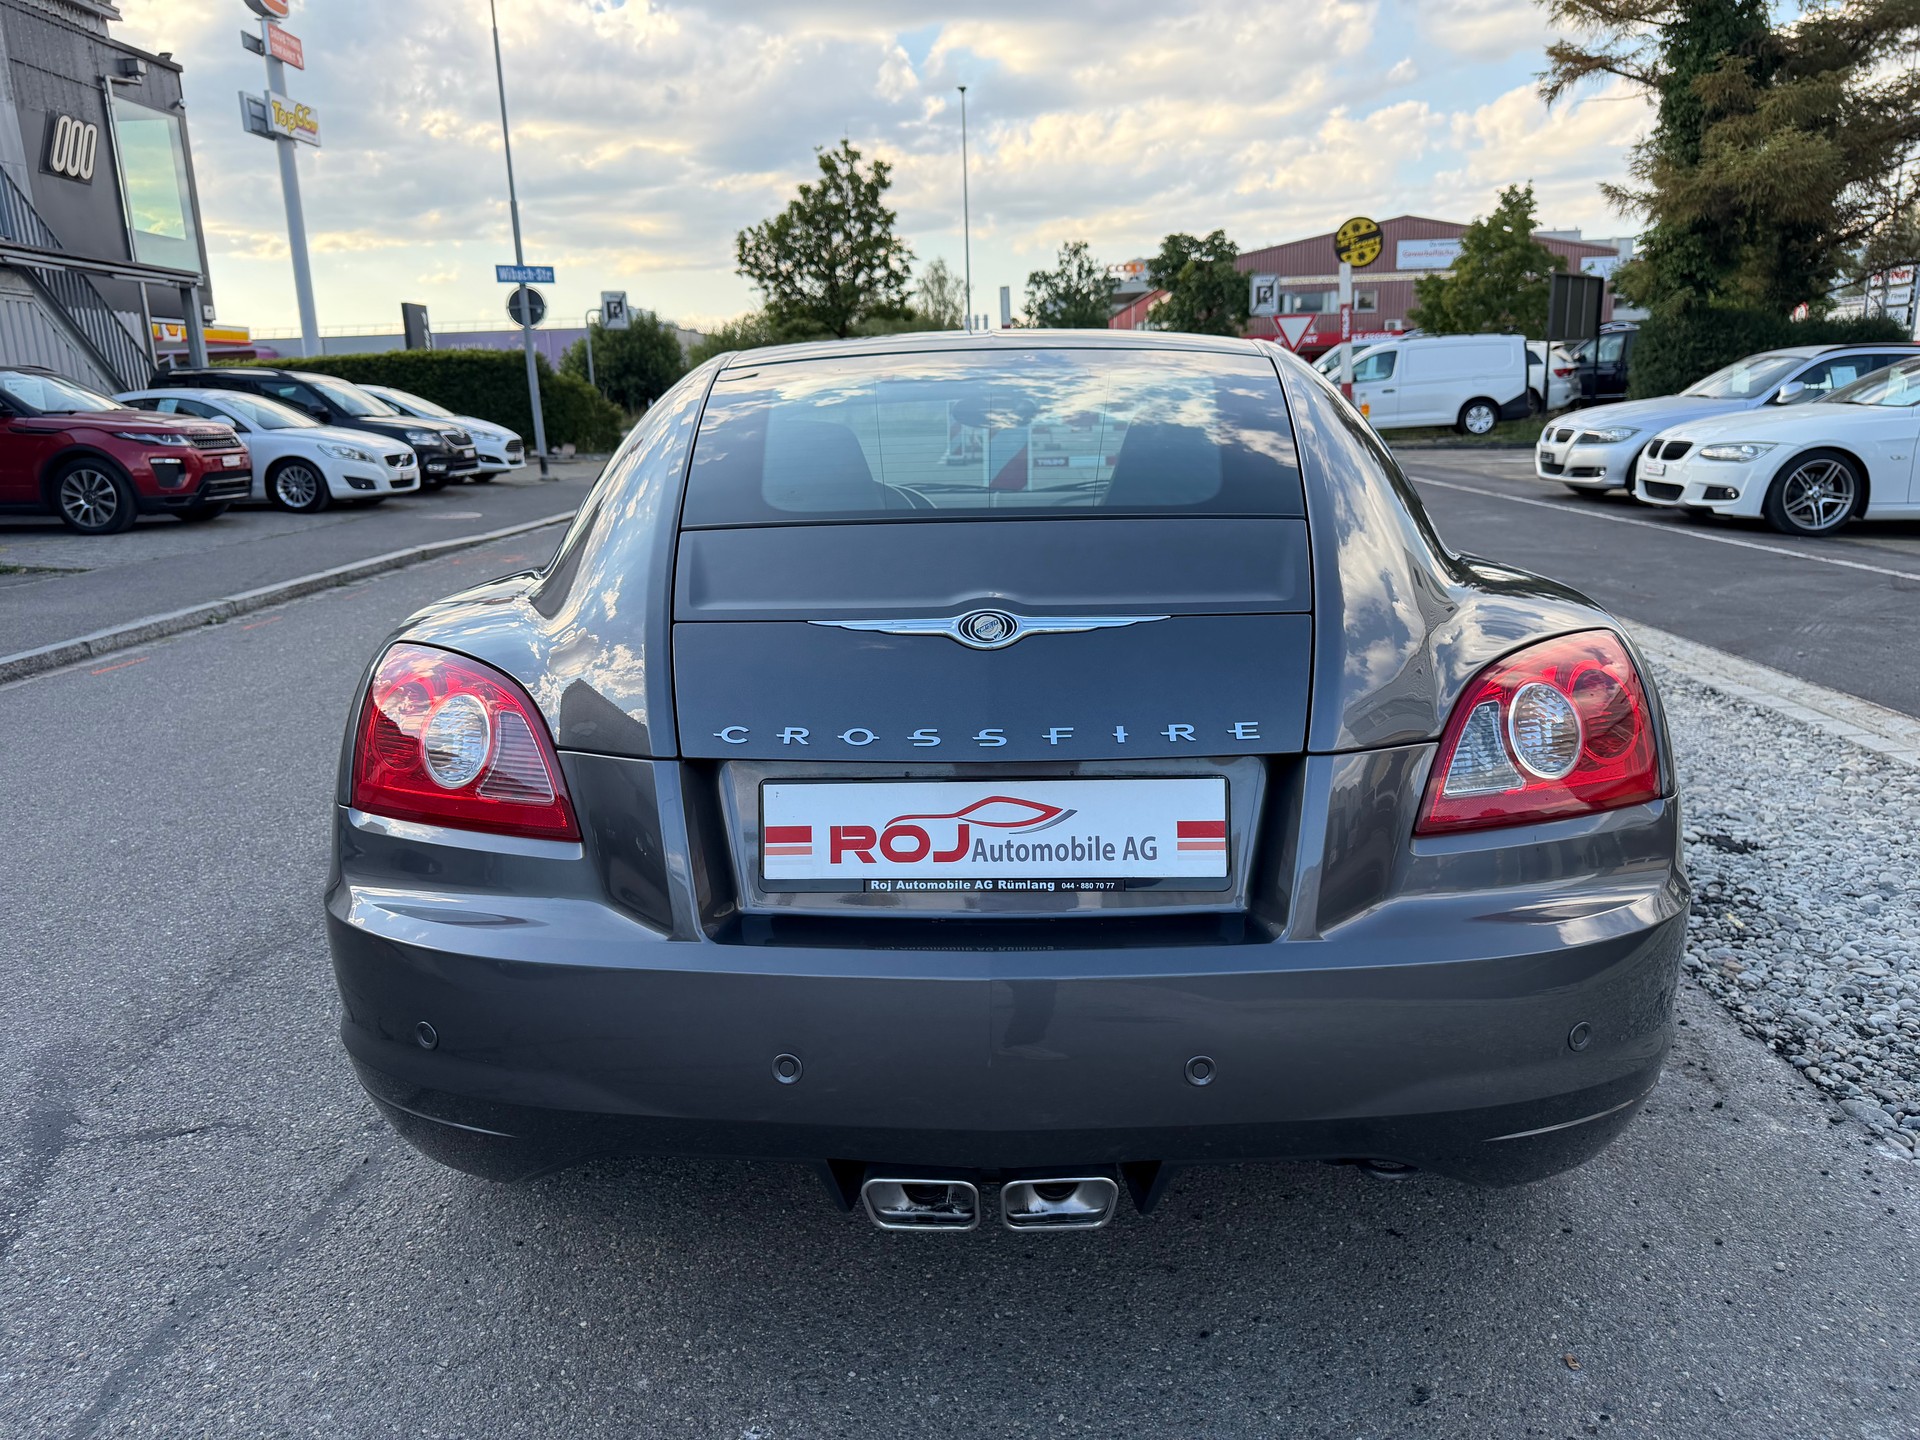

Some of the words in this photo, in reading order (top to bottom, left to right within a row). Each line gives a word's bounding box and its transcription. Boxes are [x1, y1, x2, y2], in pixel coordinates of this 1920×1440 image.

[272, 100, 311, 132] TopCC
[713, 721, 1261, 748] CROSSFIRE
[829, 823, 970, 865] ROJ
[972, 835, 1115, 863] Automobile
[1123, 836, 1158, 862] AG
[870, 880, 892, 891] Roj
[896, 879, 971, 890] Automobile
[974, 880, 993, 890] AG
[998, 879, 1055, 892] Rümlang
